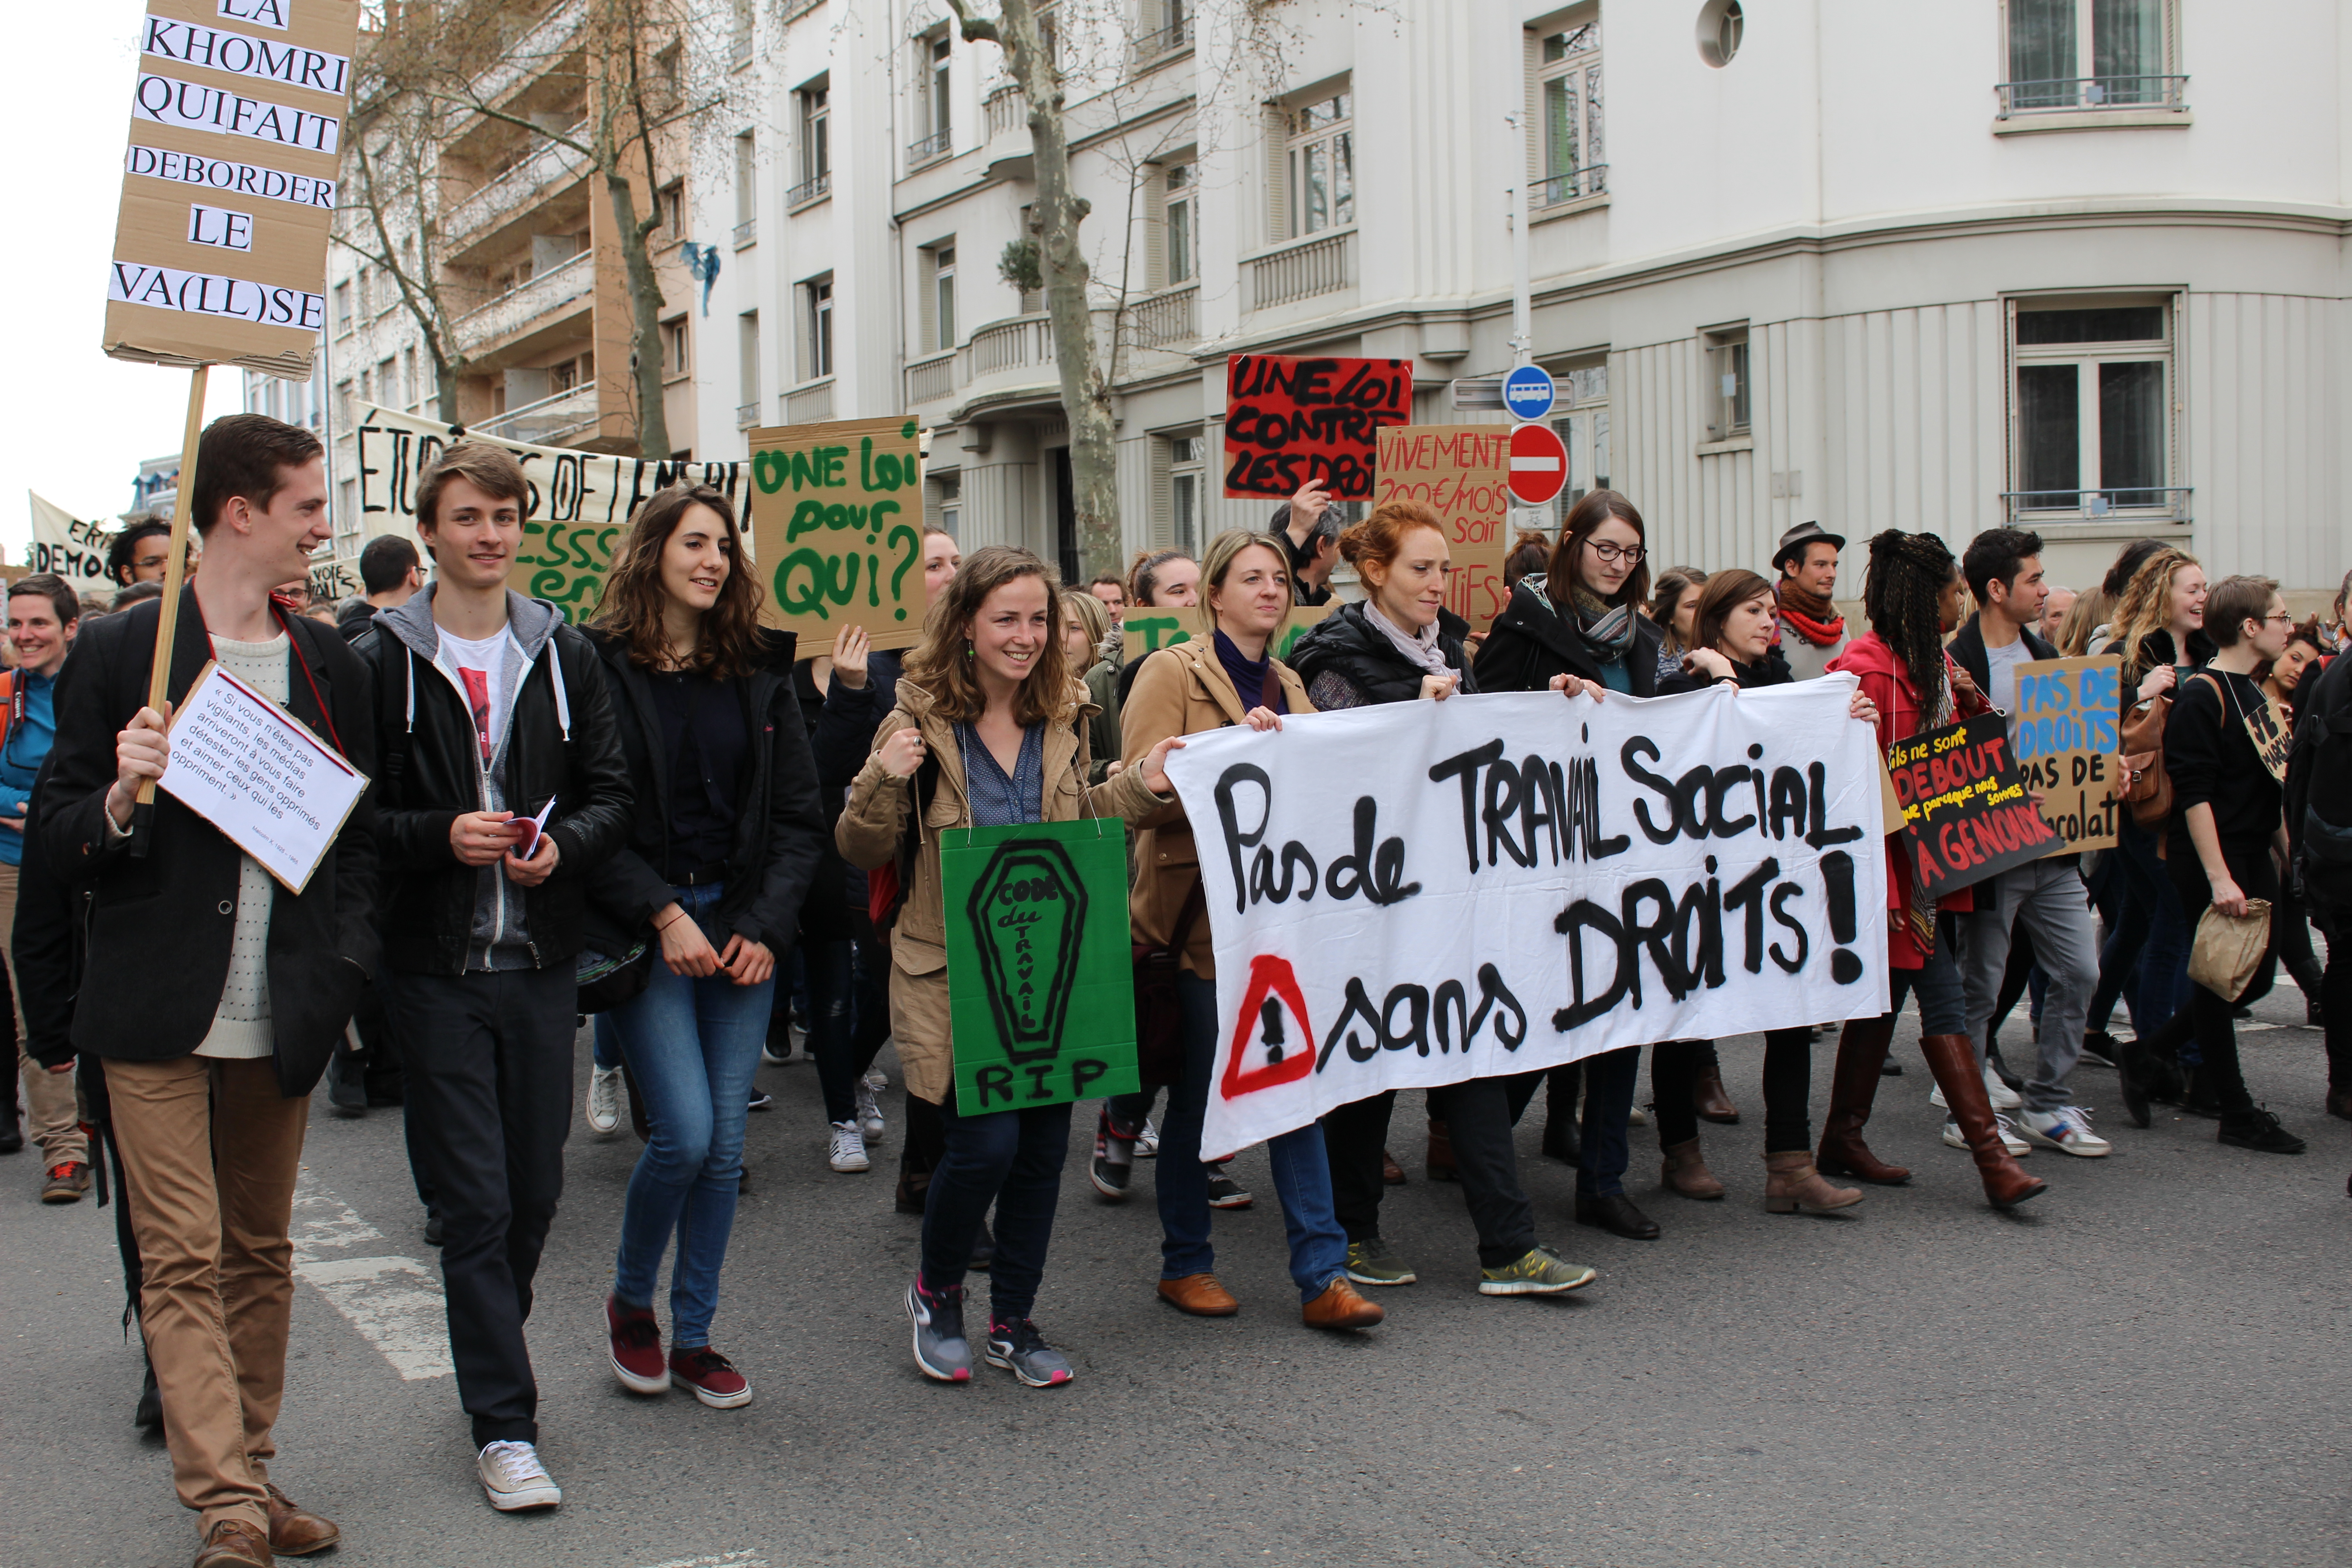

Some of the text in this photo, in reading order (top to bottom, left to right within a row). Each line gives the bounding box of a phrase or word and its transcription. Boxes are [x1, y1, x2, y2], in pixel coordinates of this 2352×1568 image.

[142, 18, 349, 93] KHOMRI
[129, 147, 333, 208] DEBORDER
[189, 208, 250, 249] LE
[113, 264, 324, 328] VA(LL)SE
[1234, 356, 1339, 406] UNE
[1225, 405, 1405, 449] CONTRE
[1226, 450, 1376, 497] LES DROI
[2021, 666, 2119, 713] PAS DE
[197, 711, 305, 798] arriveront à vous faire
[207, 700, 306, 779] vigilants, les médias
[224, 693, 237, 707] Si
[238, 704, 263, 726] vous
[294, 748, 314, 767] pas
[1891, 726, 1967, 769] ils ne sont
[172, 750, 226, 794] oppriment.
[180, 737, 284, 819] et aimer ceux qui les
[189, 725, 320, 830] détester les gens opprimés
[1892, 737, 2004, 807] DEBOUT
[1975, 776, 1998, 794] nous
[2020, 754, 2104, 791] PAS DE
[252, 825, 269, 842] Malcolm
[1325, 795, 1421, 906] de
[1939, 800, 2055, 871] GENOUX
[997, 905, 1042, 928] du
[998, 874, 1058, 906] CODE
[1315, 962, 1527, 1074] sans
